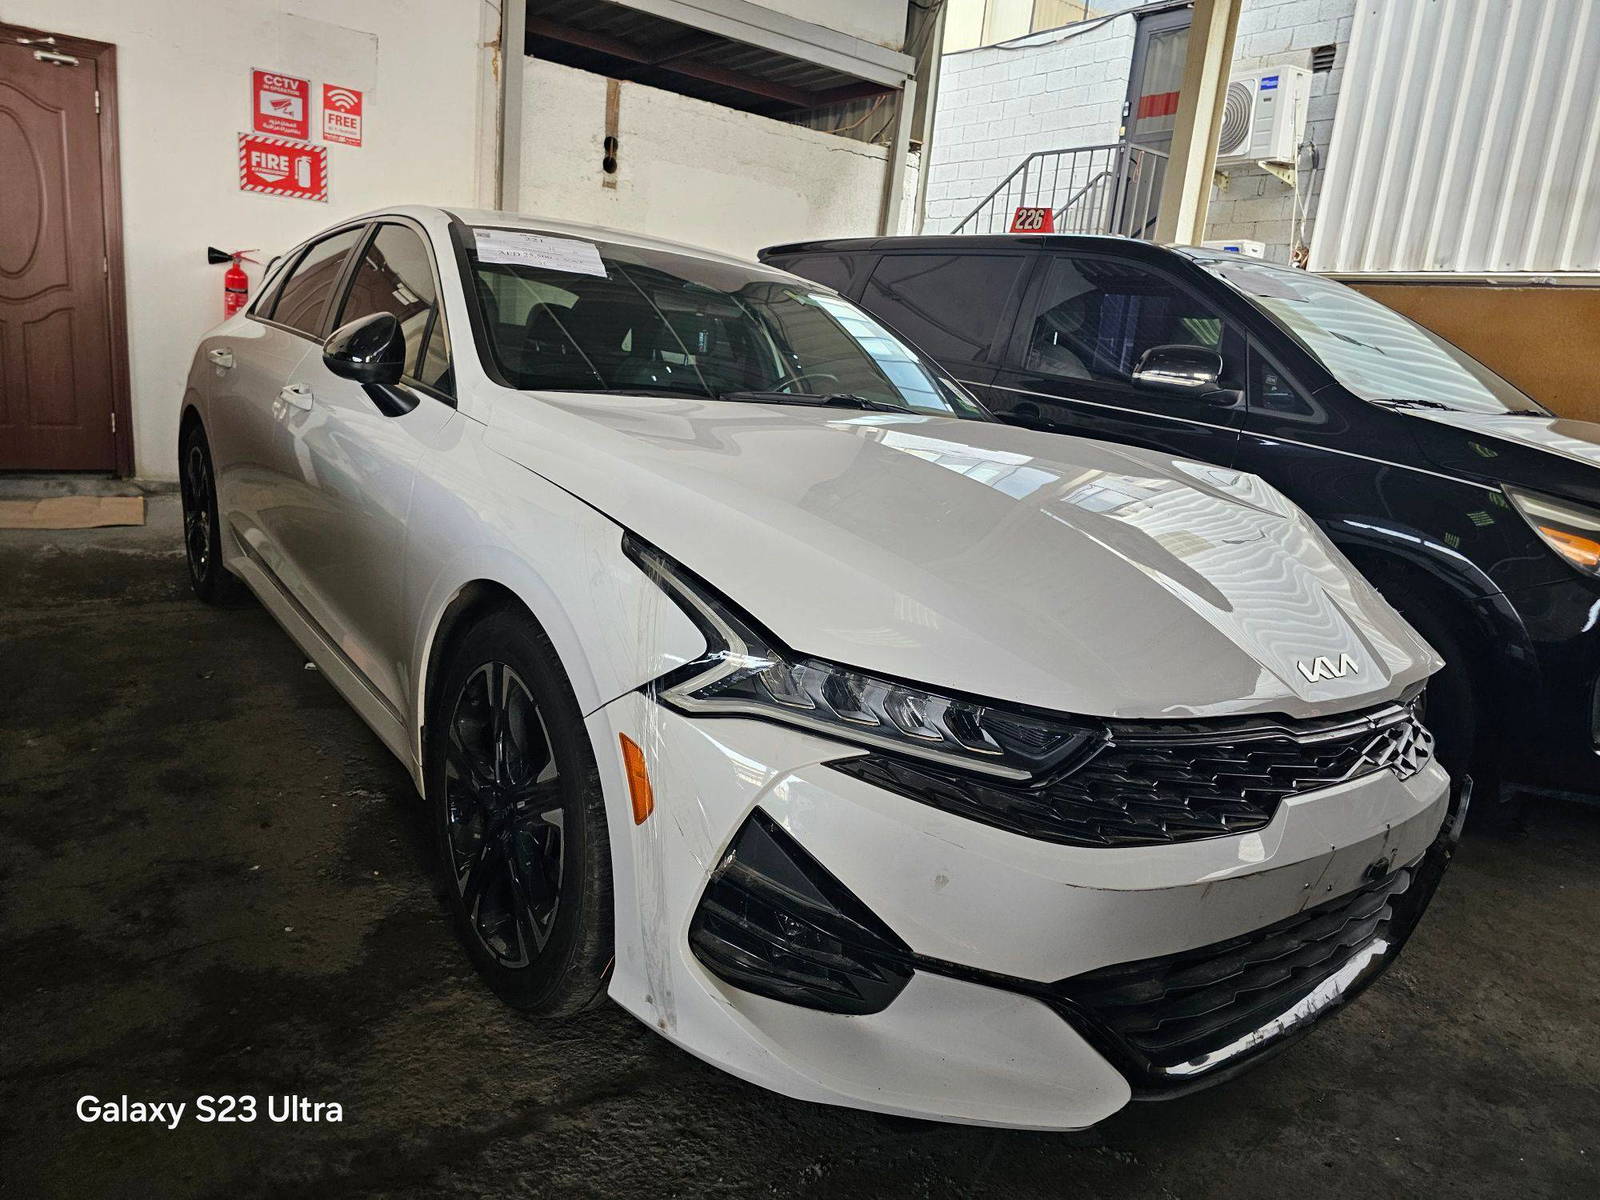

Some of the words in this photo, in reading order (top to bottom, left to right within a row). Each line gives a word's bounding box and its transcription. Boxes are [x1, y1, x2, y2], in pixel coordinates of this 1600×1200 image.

[263, 75, 299, 89] CCTV
[328, 113, 357, 129] FREE
[251, 151, 289, 171] FIRE
[1015, 209, 1045, 230] 226
